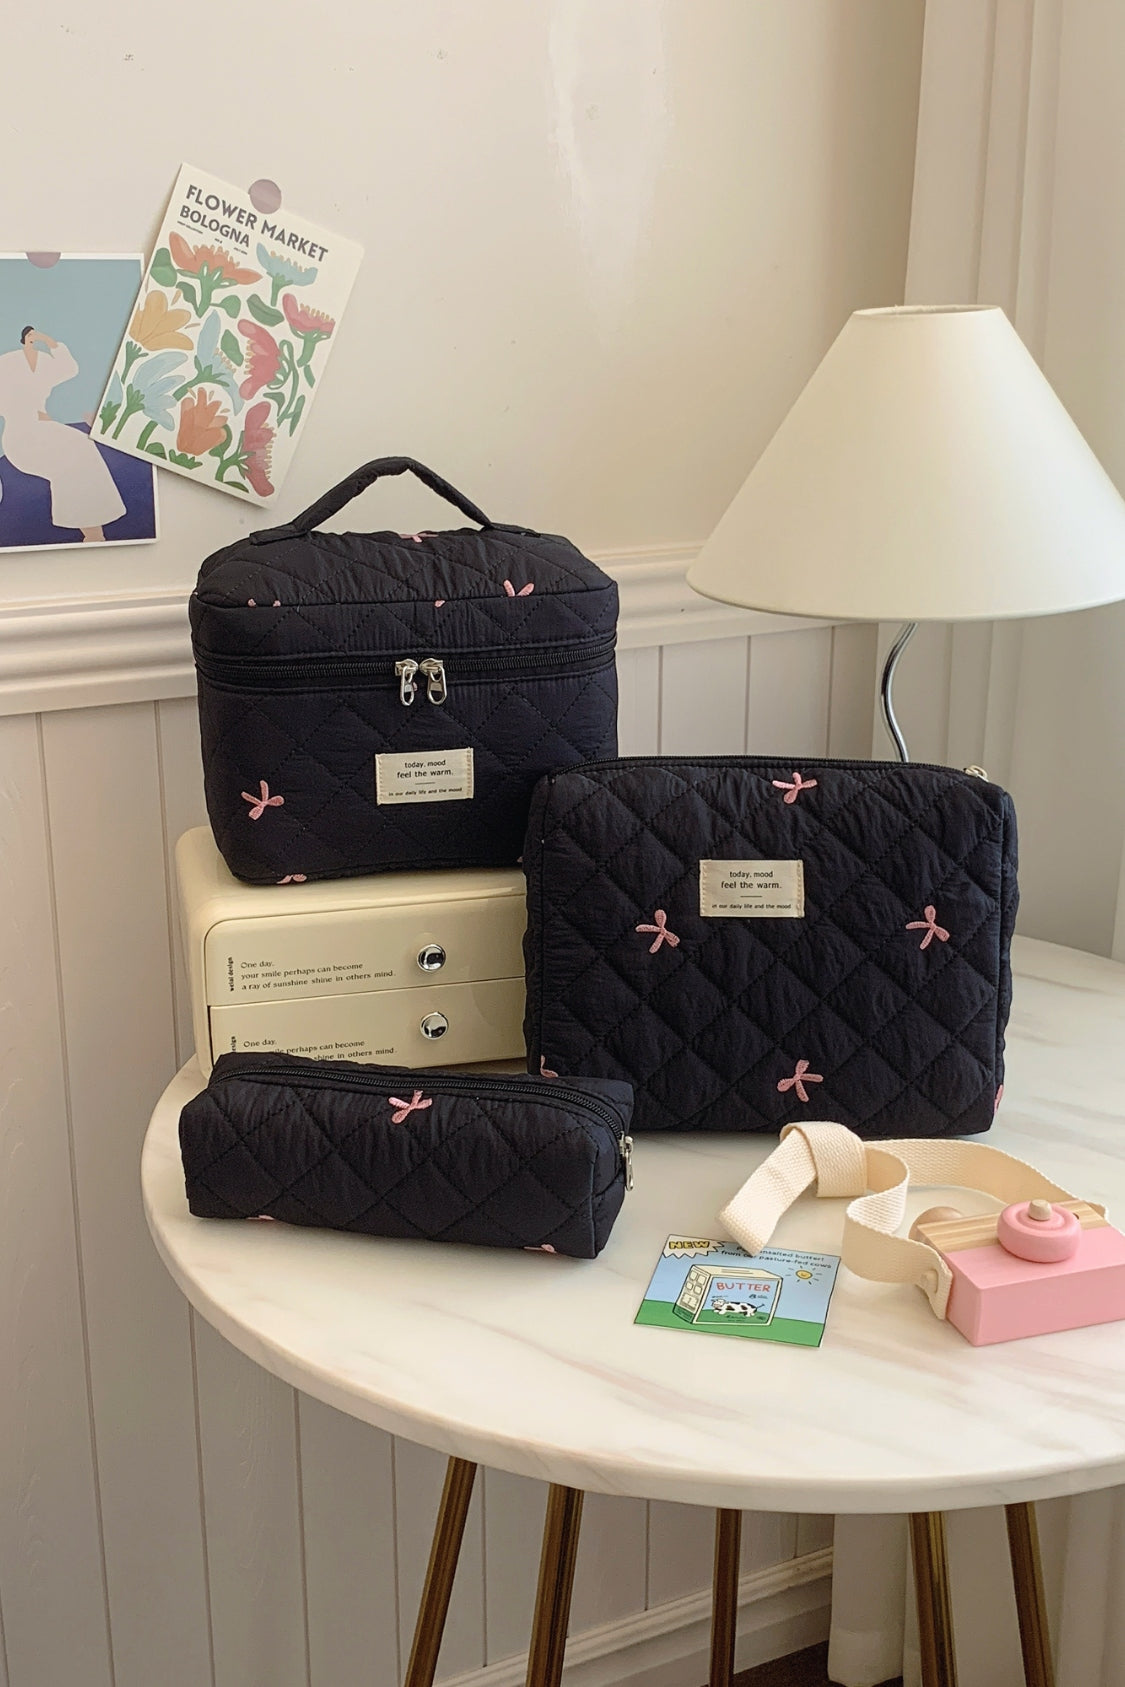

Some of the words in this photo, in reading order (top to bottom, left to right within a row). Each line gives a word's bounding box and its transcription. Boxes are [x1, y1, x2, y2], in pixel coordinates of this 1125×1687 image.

[180, 205, 250, 248] BOLOGNA
[186, 184, 258, 230] FLOWER
[260, 220, 328, 262] MARKET
[284, 968, 315, 977] perhaps
[273, 980, 308, 988] sunshine
[286, 1046, 318, 1054] perhaps
[669, 1241, 710, 1250] NEW
[716, 1282, 771, 1292] BUTTER
